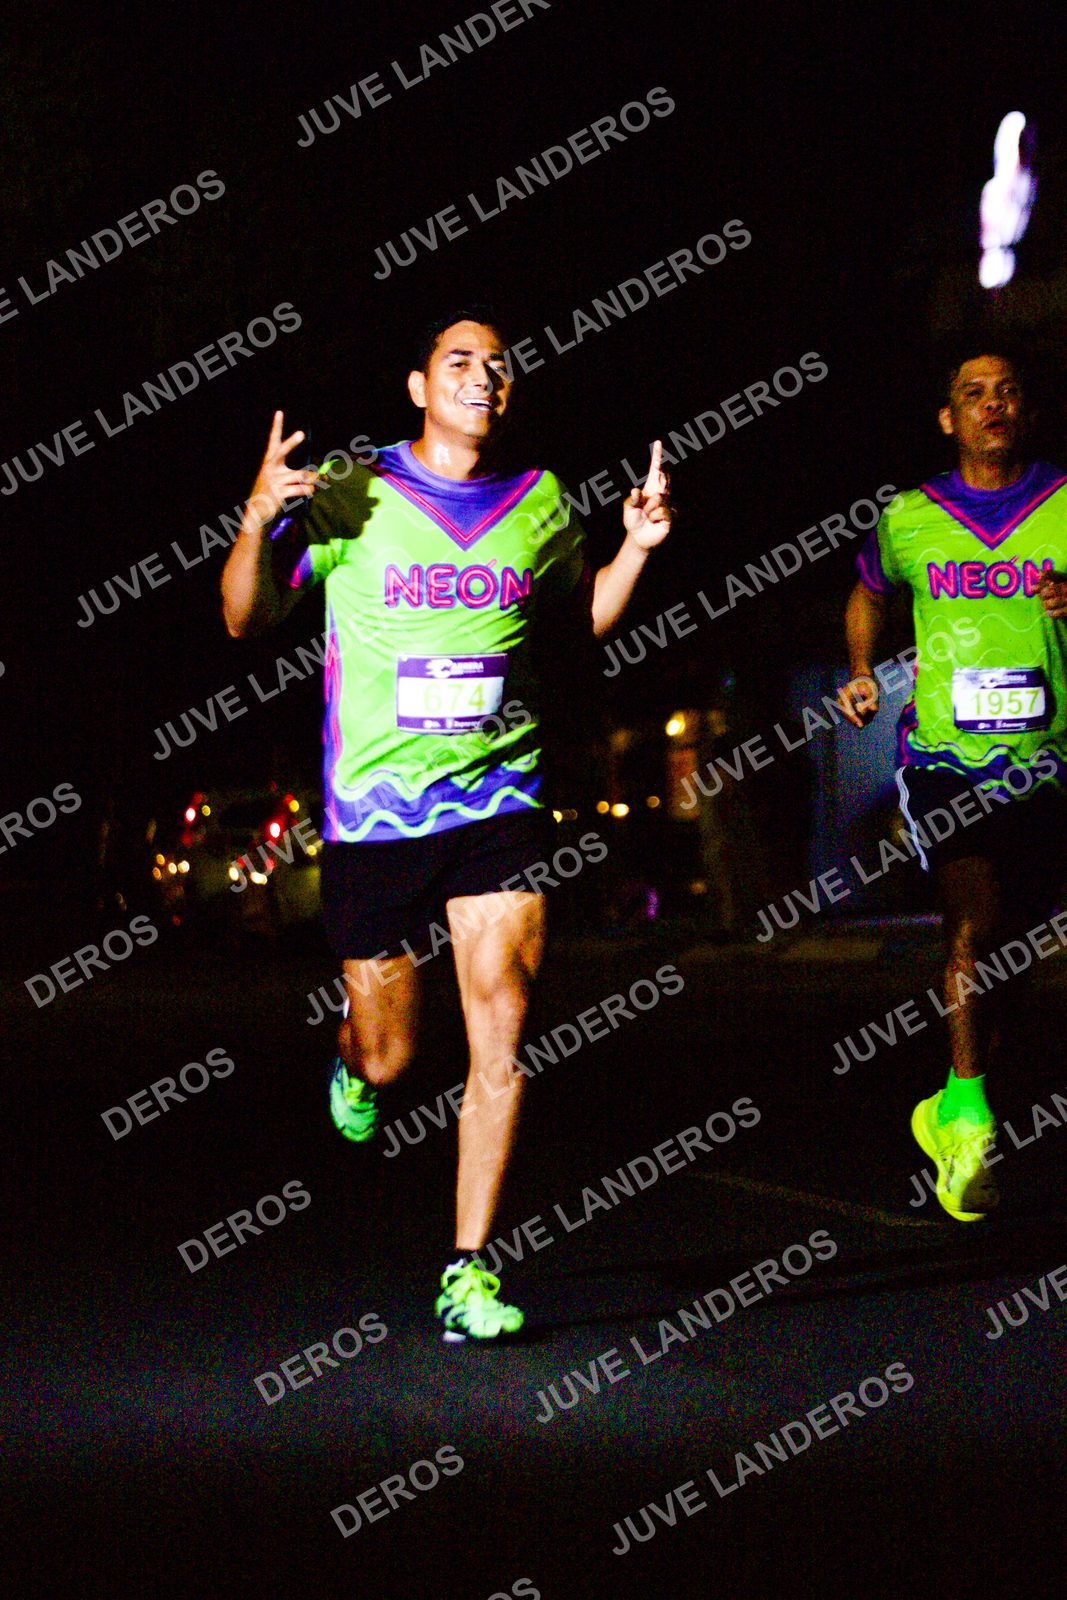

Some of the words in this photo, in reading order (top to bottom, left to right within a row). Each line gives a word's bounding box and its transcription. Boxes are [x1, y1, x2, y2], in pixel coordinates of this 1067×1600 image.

[384, 558, 533, 611] NEÓN
[422, 681, 486, 715] 674
[972, 687, 1041, 716] 1957
